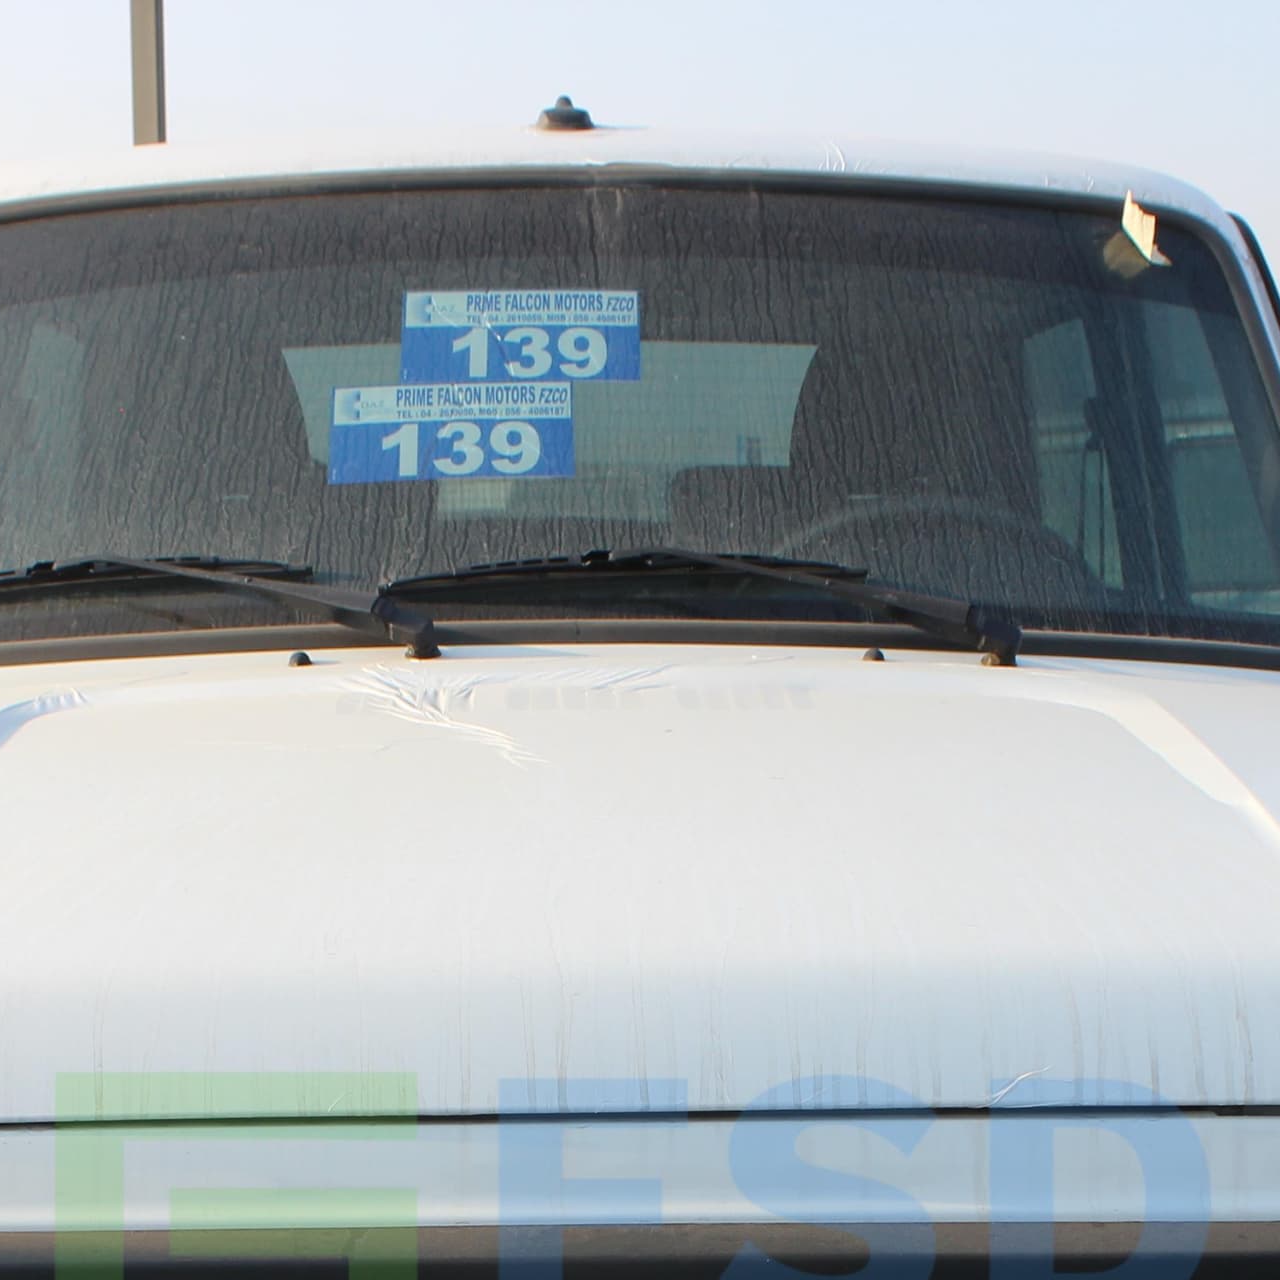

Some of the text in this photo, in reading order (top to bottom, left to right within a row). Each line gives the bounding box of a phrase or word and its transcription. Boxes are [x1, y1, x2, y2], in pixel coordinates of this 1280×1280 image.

[466, 293, 635, 312] PRIME FALCON MOTORS FZCO
[452, 327, 608, 379] 139
[396, 385, 568, 408] PRIME FALCON MOTORS FZCO
[396, 410, 412, 419] TEL
[381, 420, 541, 477] 139
